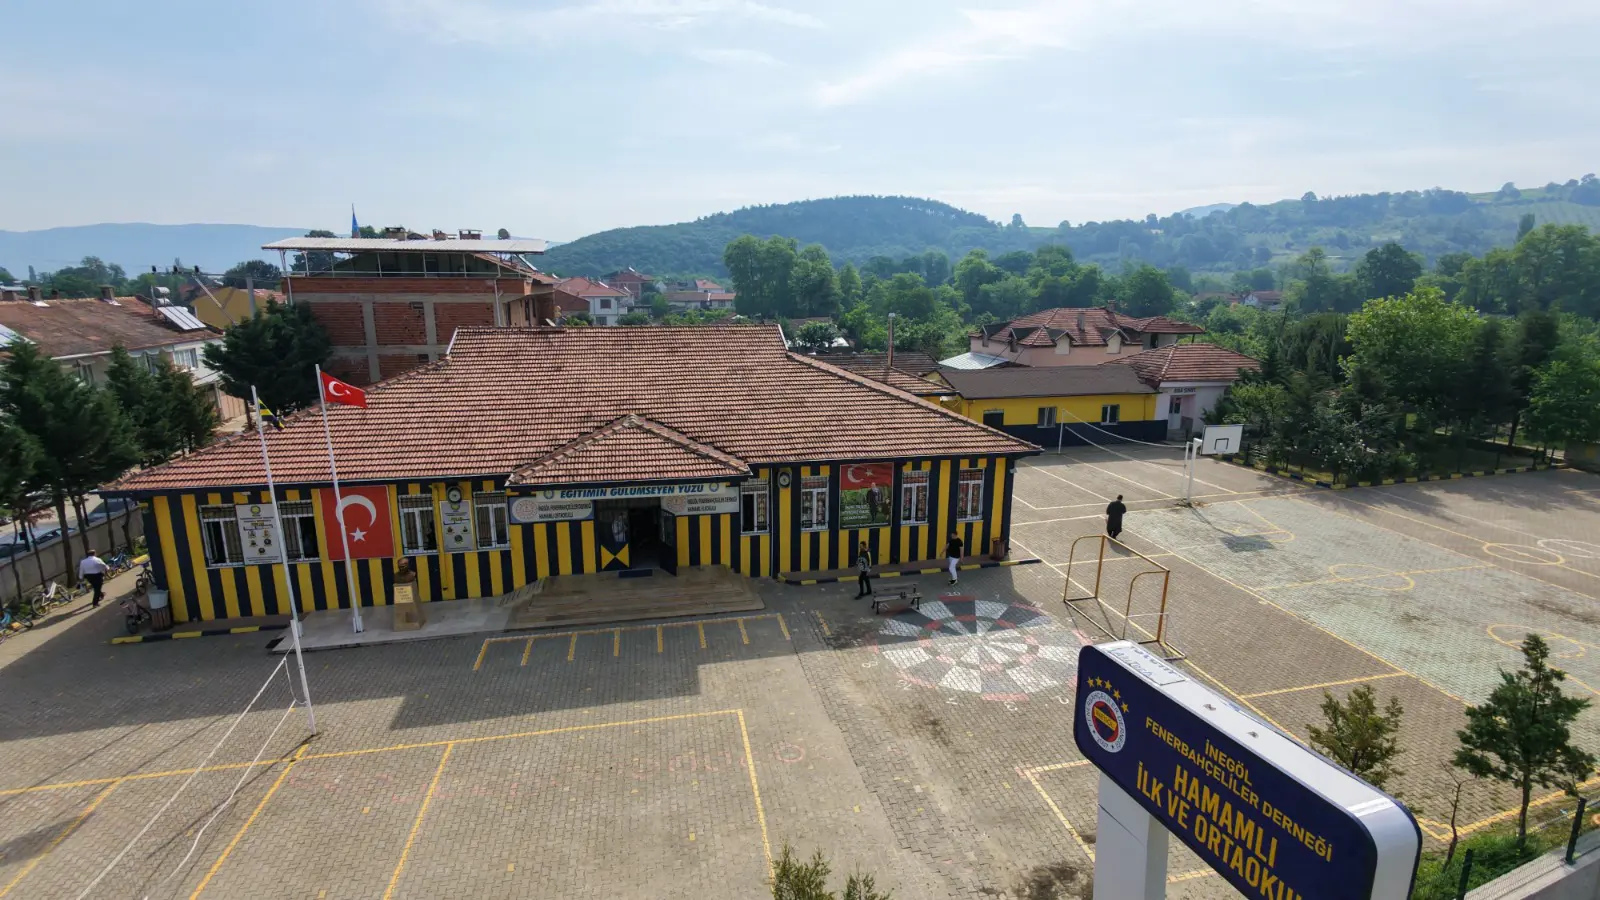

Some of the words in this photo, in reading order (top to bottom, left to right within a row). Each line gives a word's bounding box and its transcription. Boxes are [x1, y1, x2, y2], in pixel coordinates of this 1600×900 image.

[1145, 717, 1260, 809] FENERBAHÇELİLER
[1262, 801, 1333, 862] DERNEĞİ
[1174, 765, 1278, 868] HAMAMLI
[1205, 736, 1252, 787] İNEGÖL
[1136, 763, 1163, 806] İLK
[1167, 790, 1190, 829] VE
[1194, 815, 1302, 900] ORTAOKU
